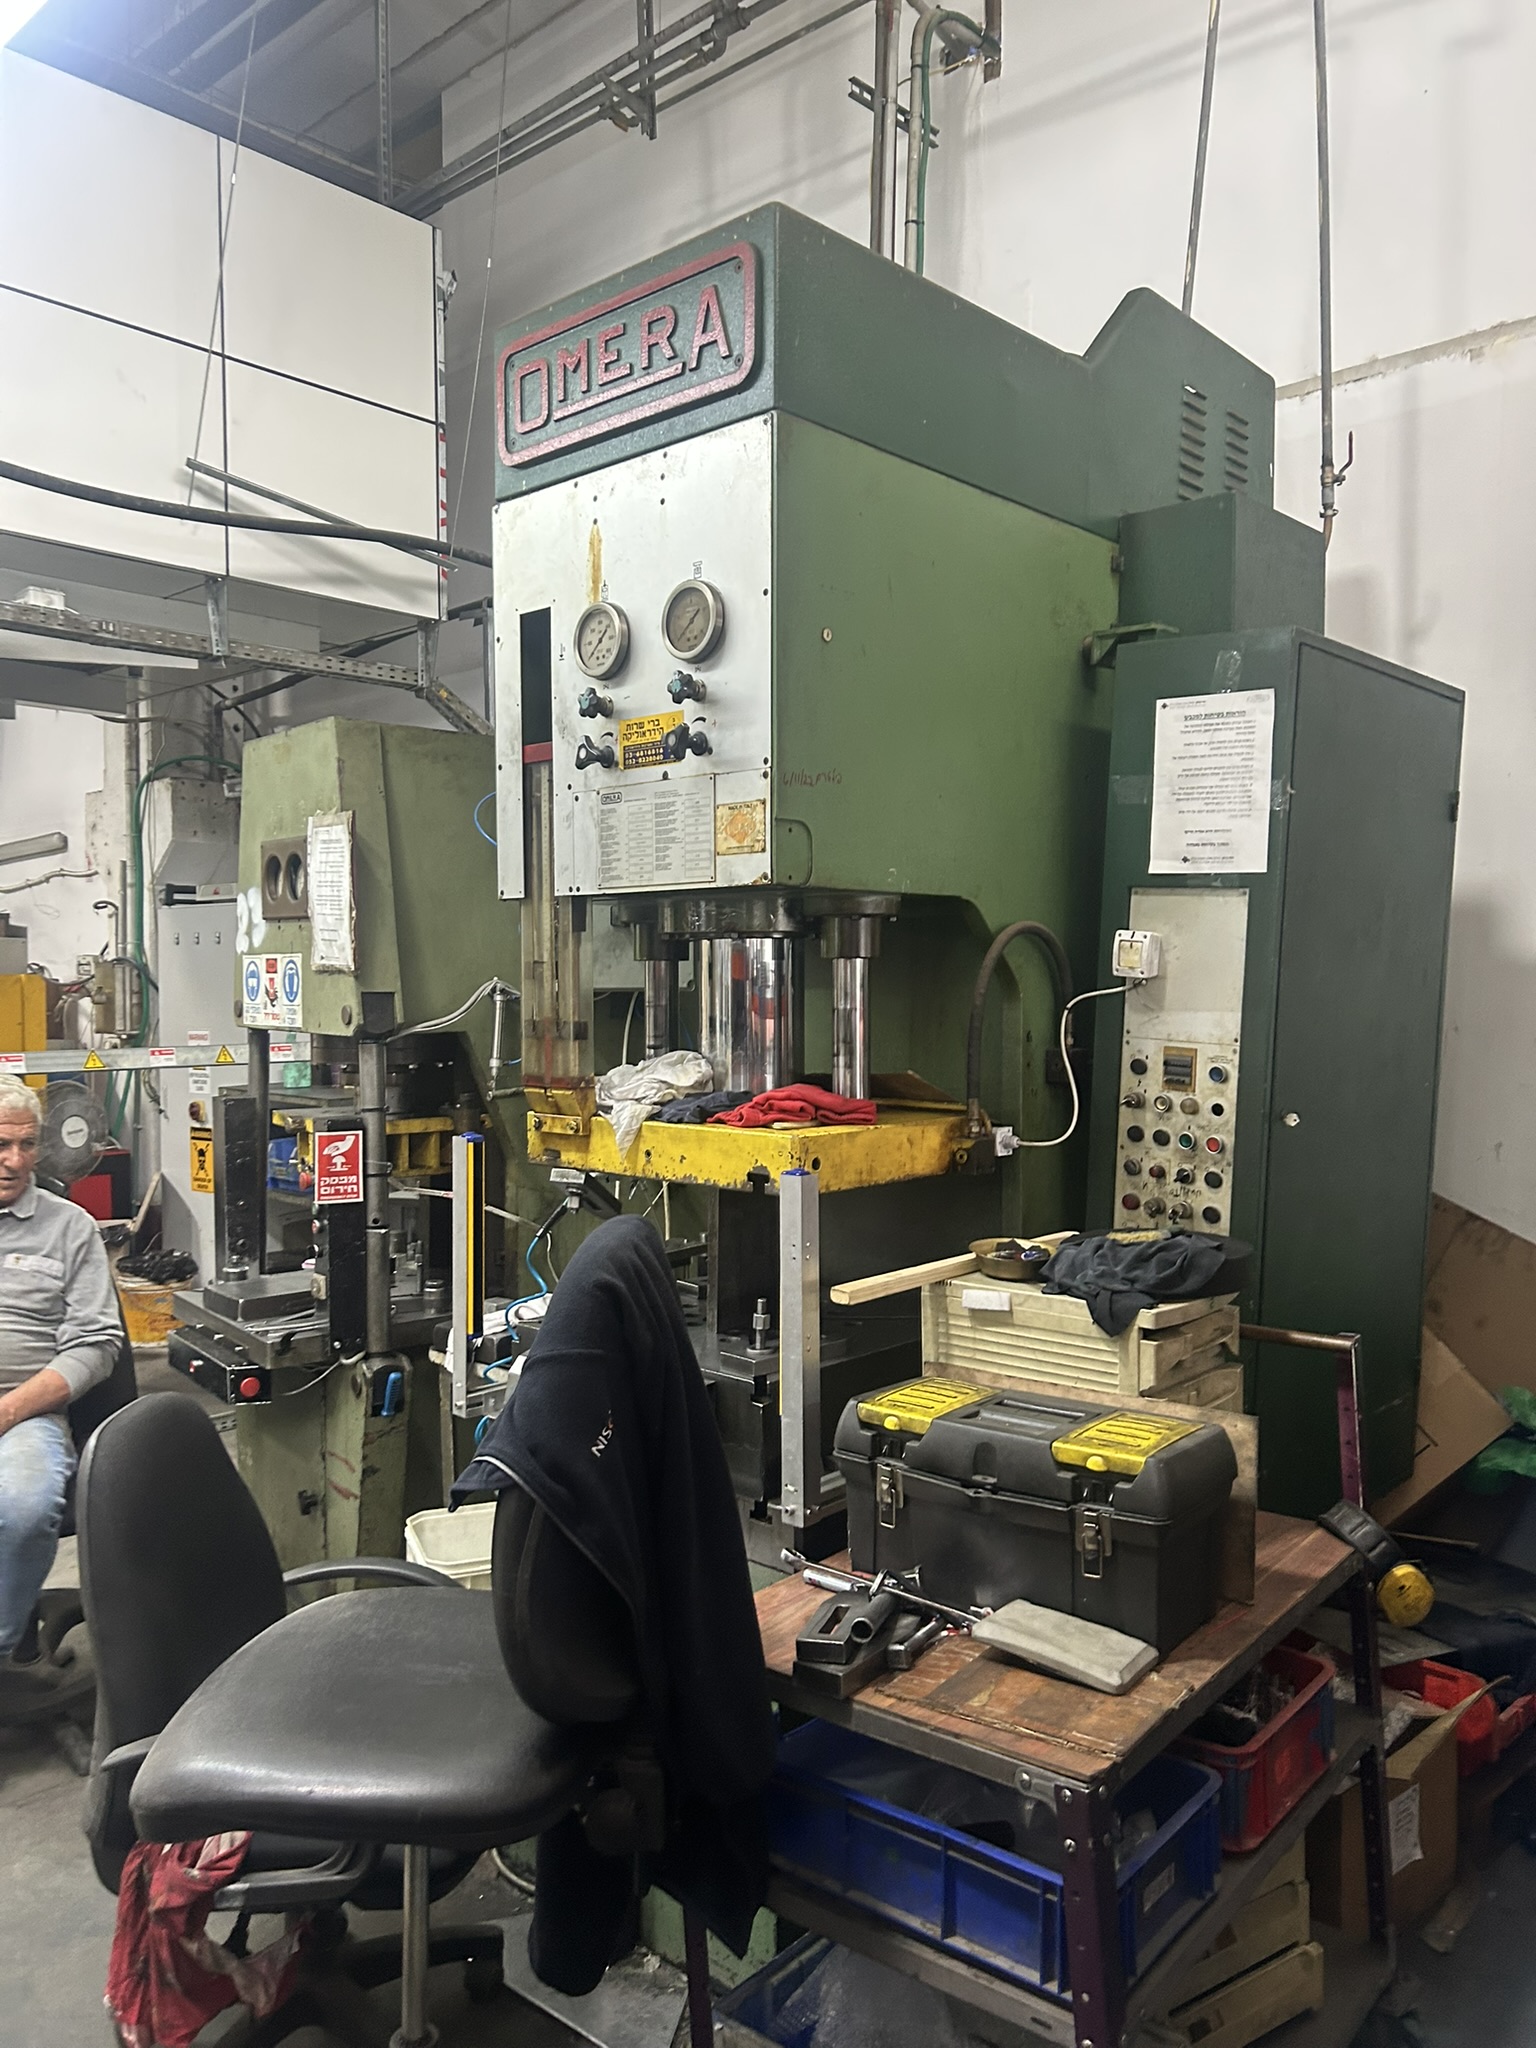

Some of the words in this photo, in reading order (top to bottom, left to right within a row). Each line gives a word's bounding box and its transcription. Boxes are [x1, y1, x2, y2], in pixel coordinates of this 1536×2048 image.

[514, 285, 730, 434] OMERA
[626, 721, 645, 732] שרות
[623, 727, 665, 742] הידראוליקה
[320, 1175, 357, 1186] מפסק
[320, 1185, 358, 1195] חירום
[591, 1422, 613, 1457] NIS
